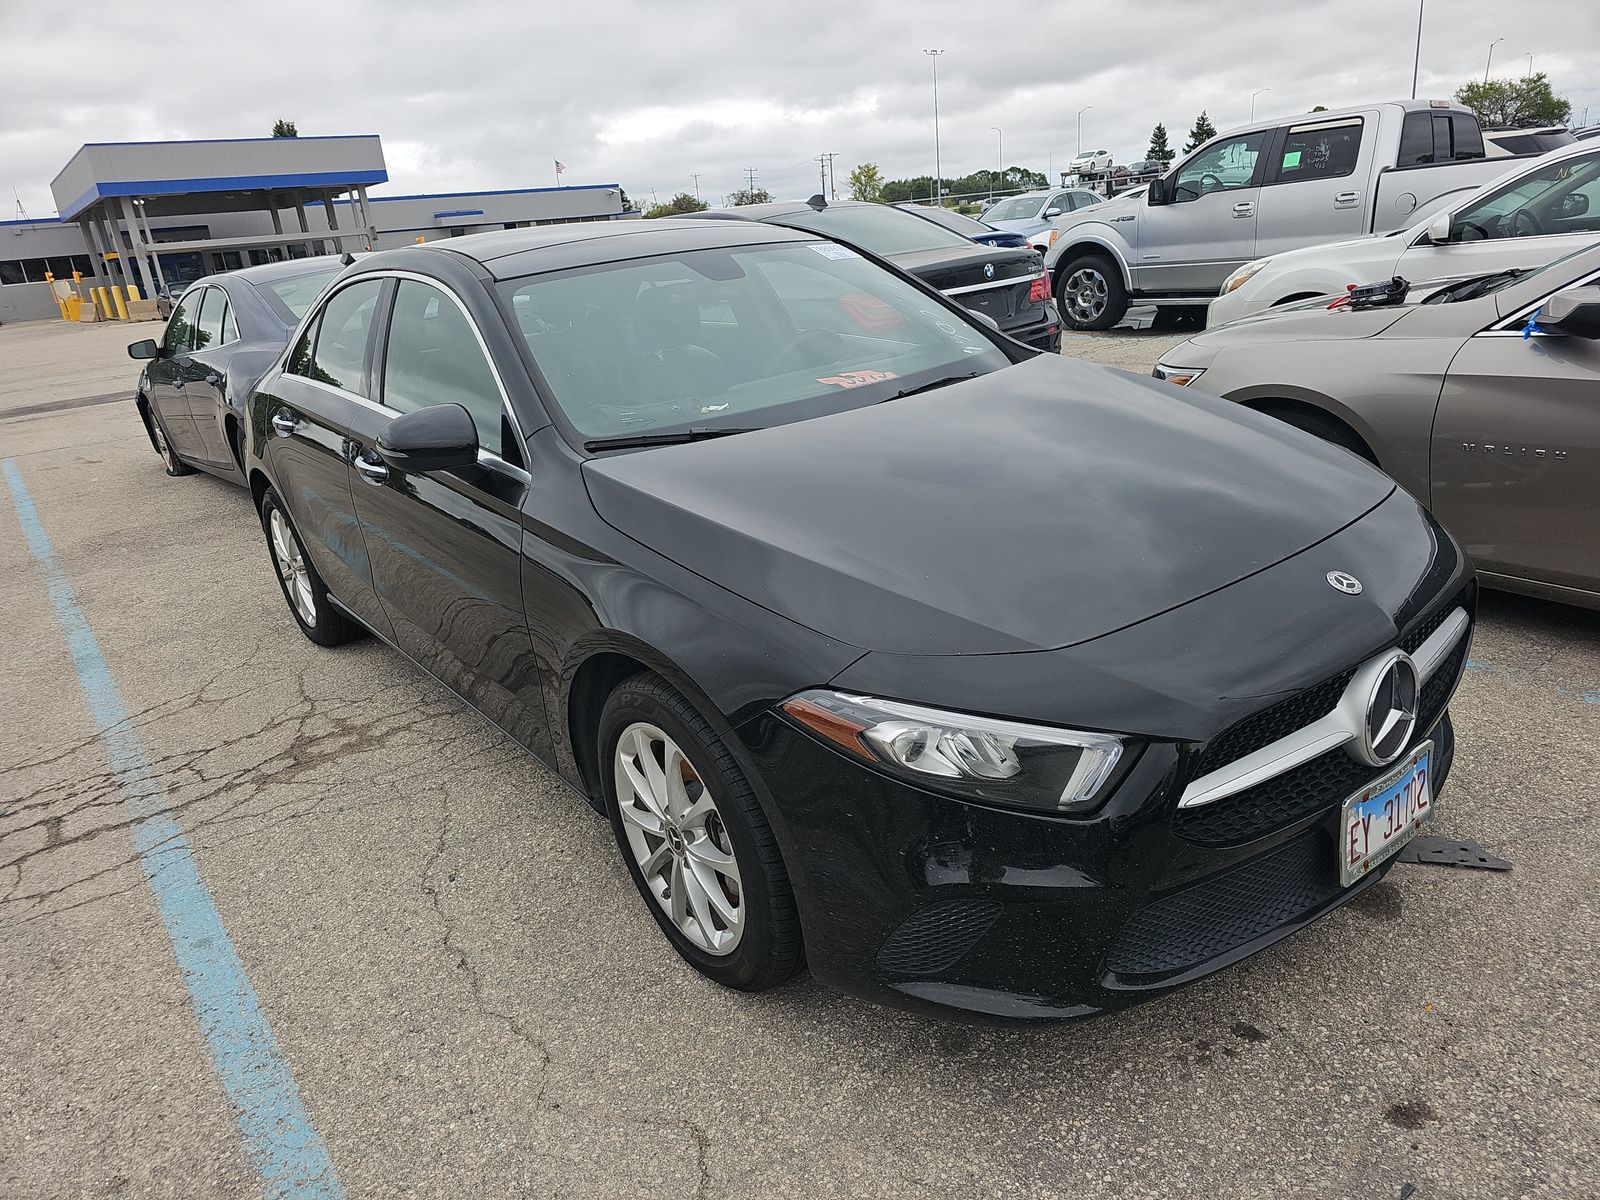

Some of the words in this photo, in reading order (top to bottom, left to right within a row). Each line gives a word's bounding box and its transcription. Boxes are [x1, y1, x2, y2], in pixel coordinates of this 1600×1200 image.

[1462, 442, 1567, 460] MALIBU
[1350, 813, 1371, 865] EY
[1384, 768, 1428, 840] 31702
